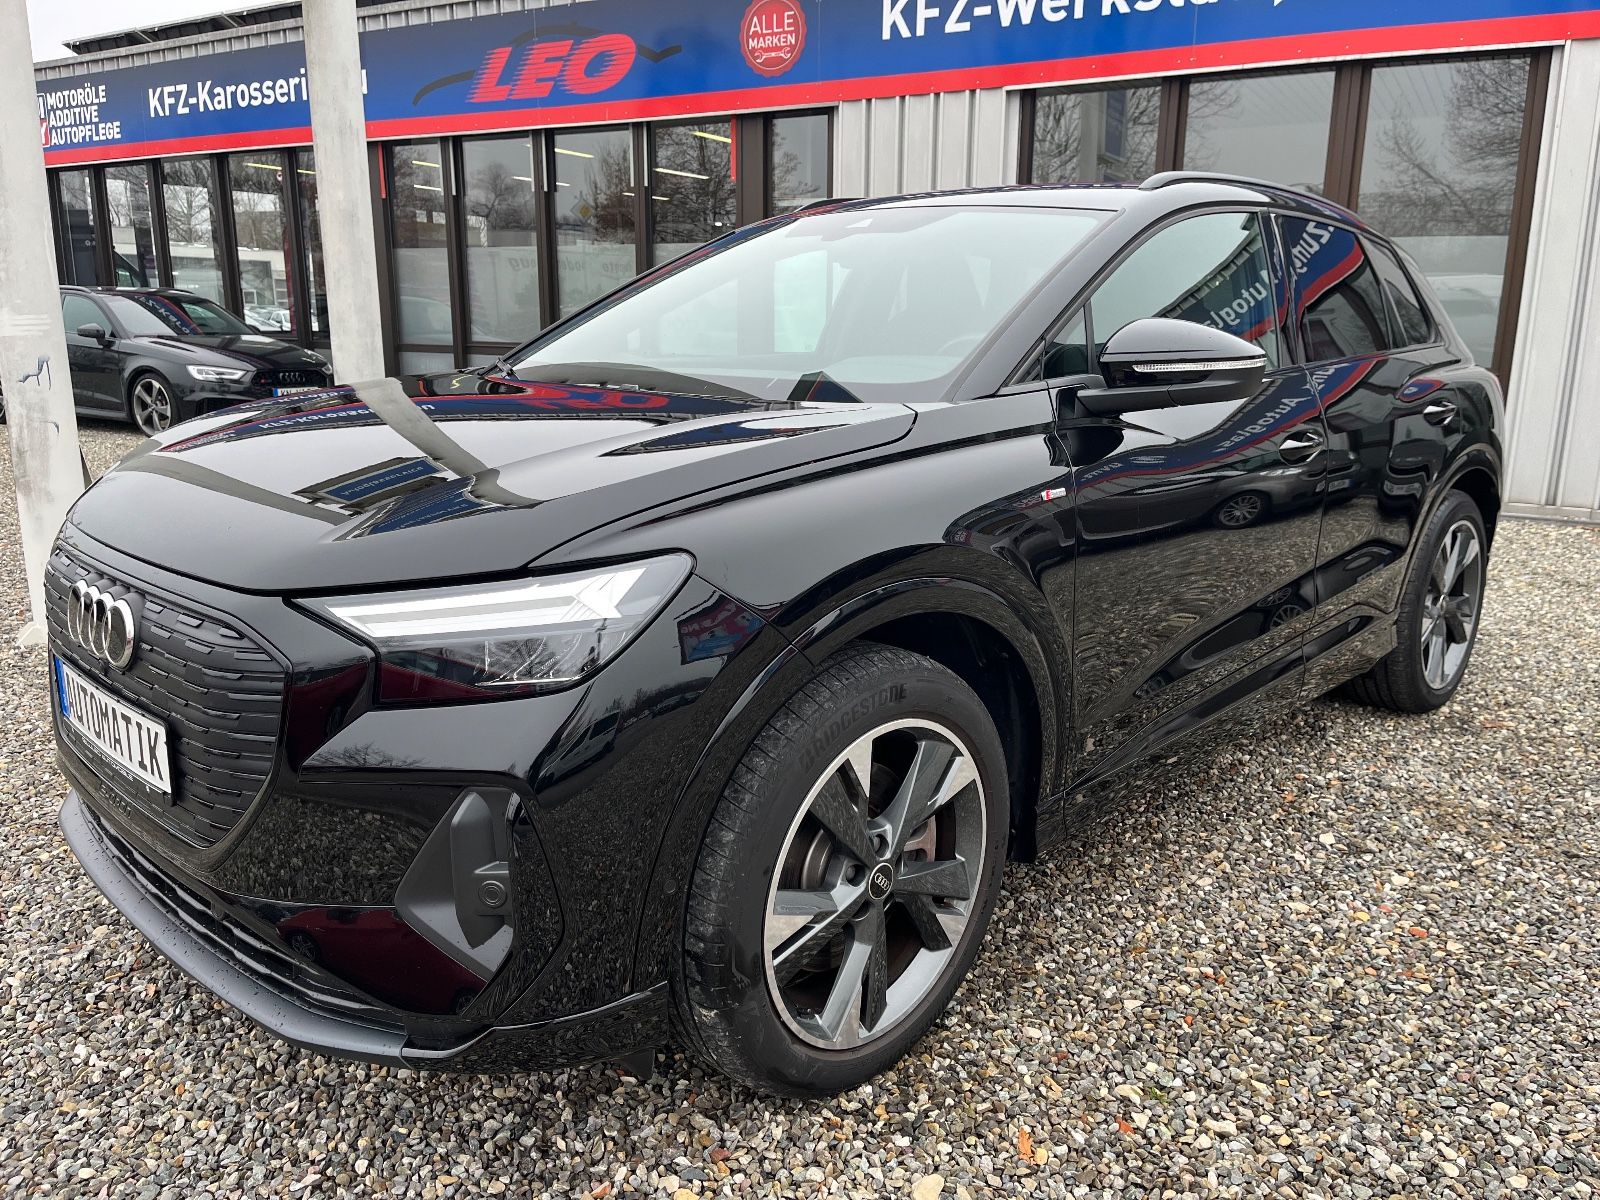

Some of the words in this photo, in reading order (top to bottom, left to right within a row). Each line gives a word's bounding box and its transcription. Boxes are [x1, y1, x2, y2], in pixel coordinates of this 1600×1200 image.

[749, 11, 794, 36] ALLE
[749, 33, 796, 50] MARKEN
[465, 33, 637, 103] LEO
[46, 83, 107, 110] MOTORÖLE
[49, 105, 99, 128] ADDITIVE
[51, 121, 122, 146] AUTOPFLEGE
[64, 670, 168, 782] AUTOMATIK
